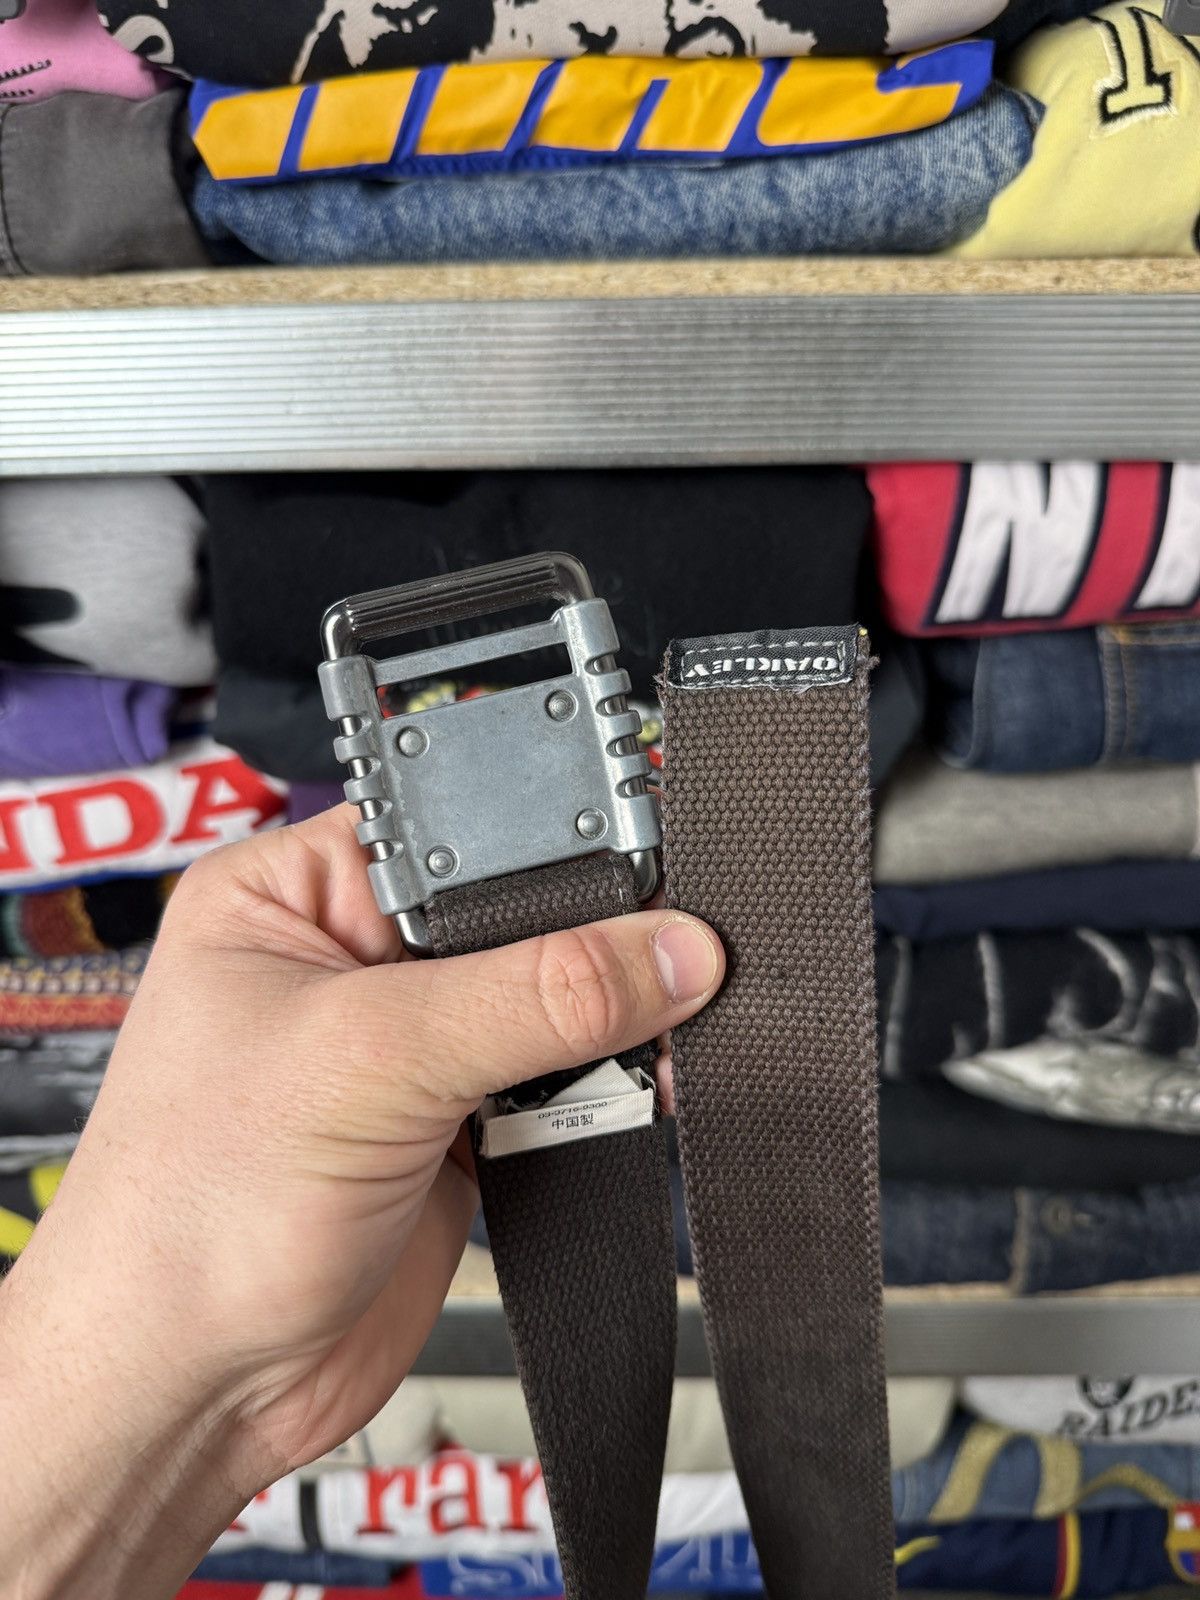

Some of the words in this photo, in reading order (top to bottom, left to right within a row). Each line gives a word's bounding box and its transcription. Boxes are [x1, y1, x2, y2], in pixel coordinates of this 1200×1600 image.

[685, 657, 838, 678] OAKLEY
[551, 1112, 595, 1130] 中国製
